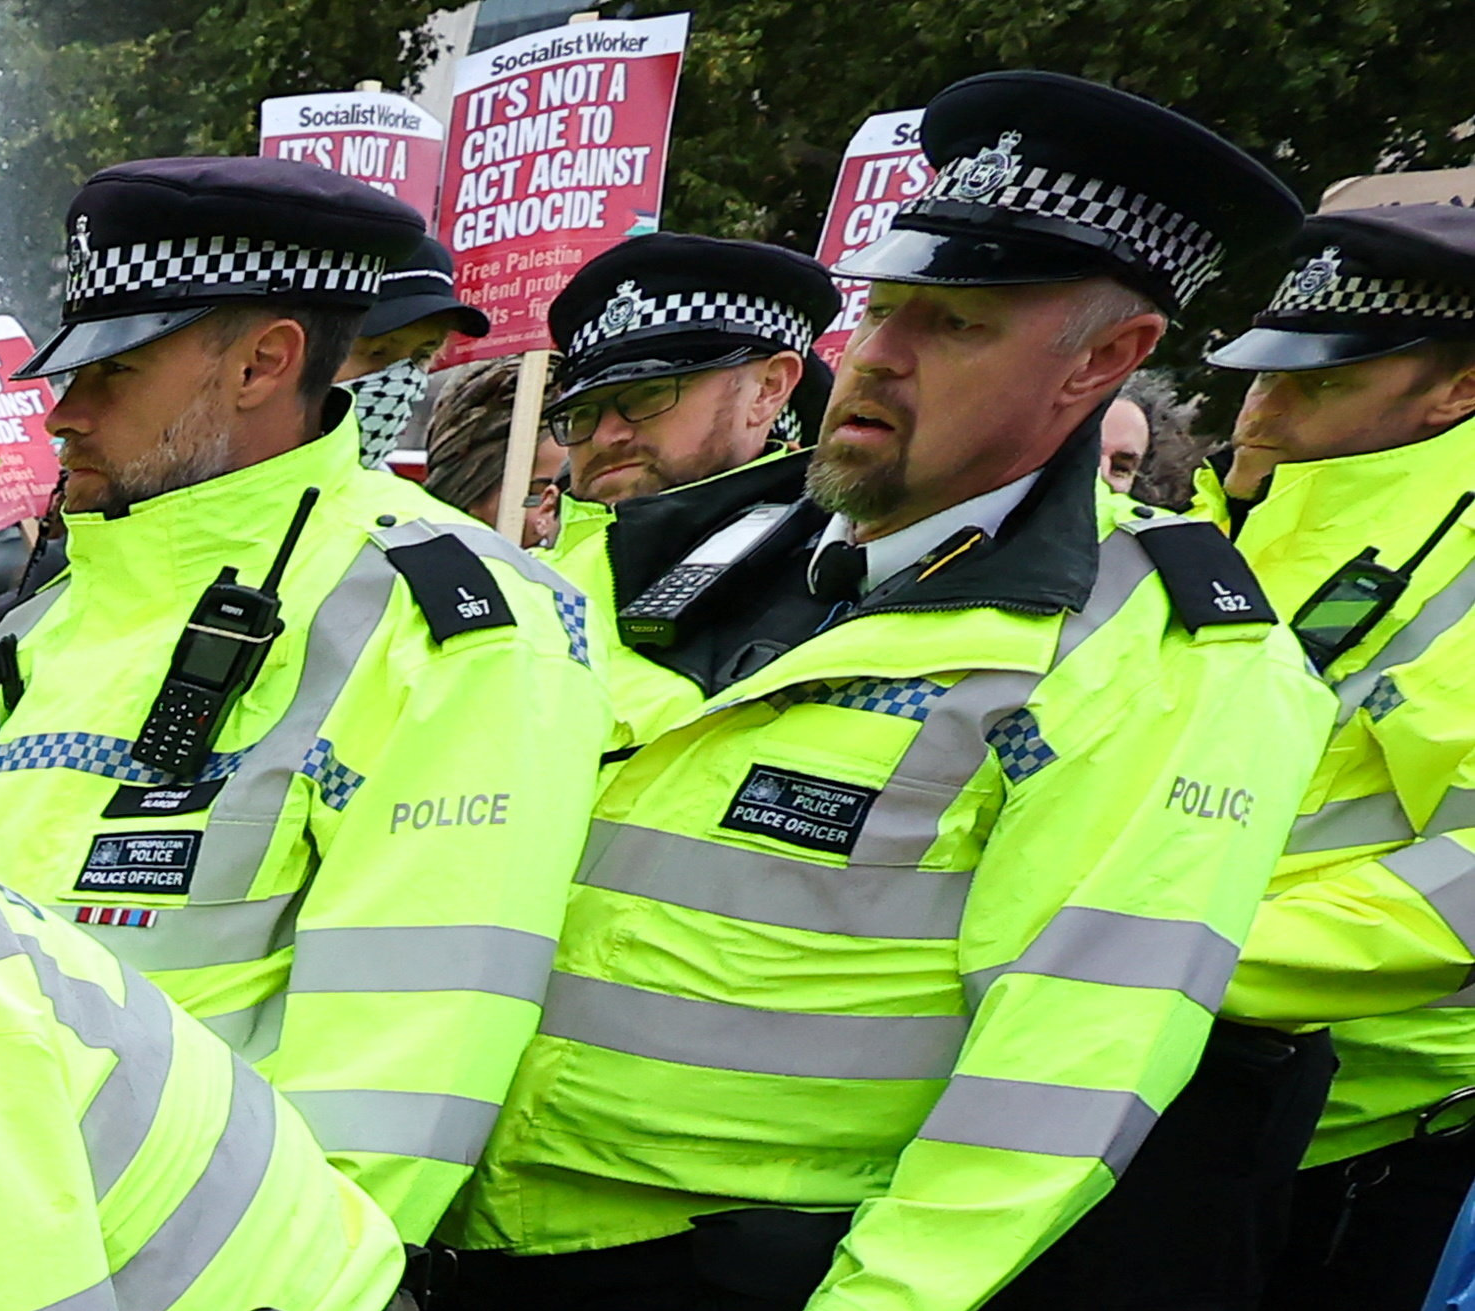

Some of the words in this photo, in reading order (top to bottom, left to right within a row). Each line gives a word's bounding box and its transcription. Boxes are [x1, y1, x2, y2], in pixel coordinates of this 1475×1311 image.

[491, 36, 583, 76] Socialist
[586, 32, 649, 52] Worker
[466, 78, 529, 130] IT'S
[538, 63, 605, 110] NOT
[607, 63, 625, 102] A
[299, 104, 375, 127] Socialist
[377, 105, 421, 130] Worker
[462, 109, 570, 170] CRIME
[578, 105, 613, 145] TO
[340, 136, 390, 176] NOT
[391, 140, 407, 180] A
[455, 160, 522, 212] ACT
[527, 147, 650, 194] AGAINST
[855, 155, 928, 202] IT'S
[453, 190, 607, 251] GENOCIDE
[461, 263, 500, 283] Free
[457, 587, 474, 601] L
[1212, 581, 1231, 596] L
[457, 599, 490, 619] 567
[1214, 595, 1251, 612] 132
[791, 784, 857, 806] METROPOLITAN
[792, 795, 841, 817] POLICE
[390, 793, 510, 834] POLICE
[732, 806, 785, 828] POLICE
[784, 818, 849, 843] OFFICER
[126, 840, 184, 849] METROPOLITAN
[129, 850, 174, 862] POLICE
[81, 871, 125, 884] POLICE
[128, 871, 183, 885] OFFICER
